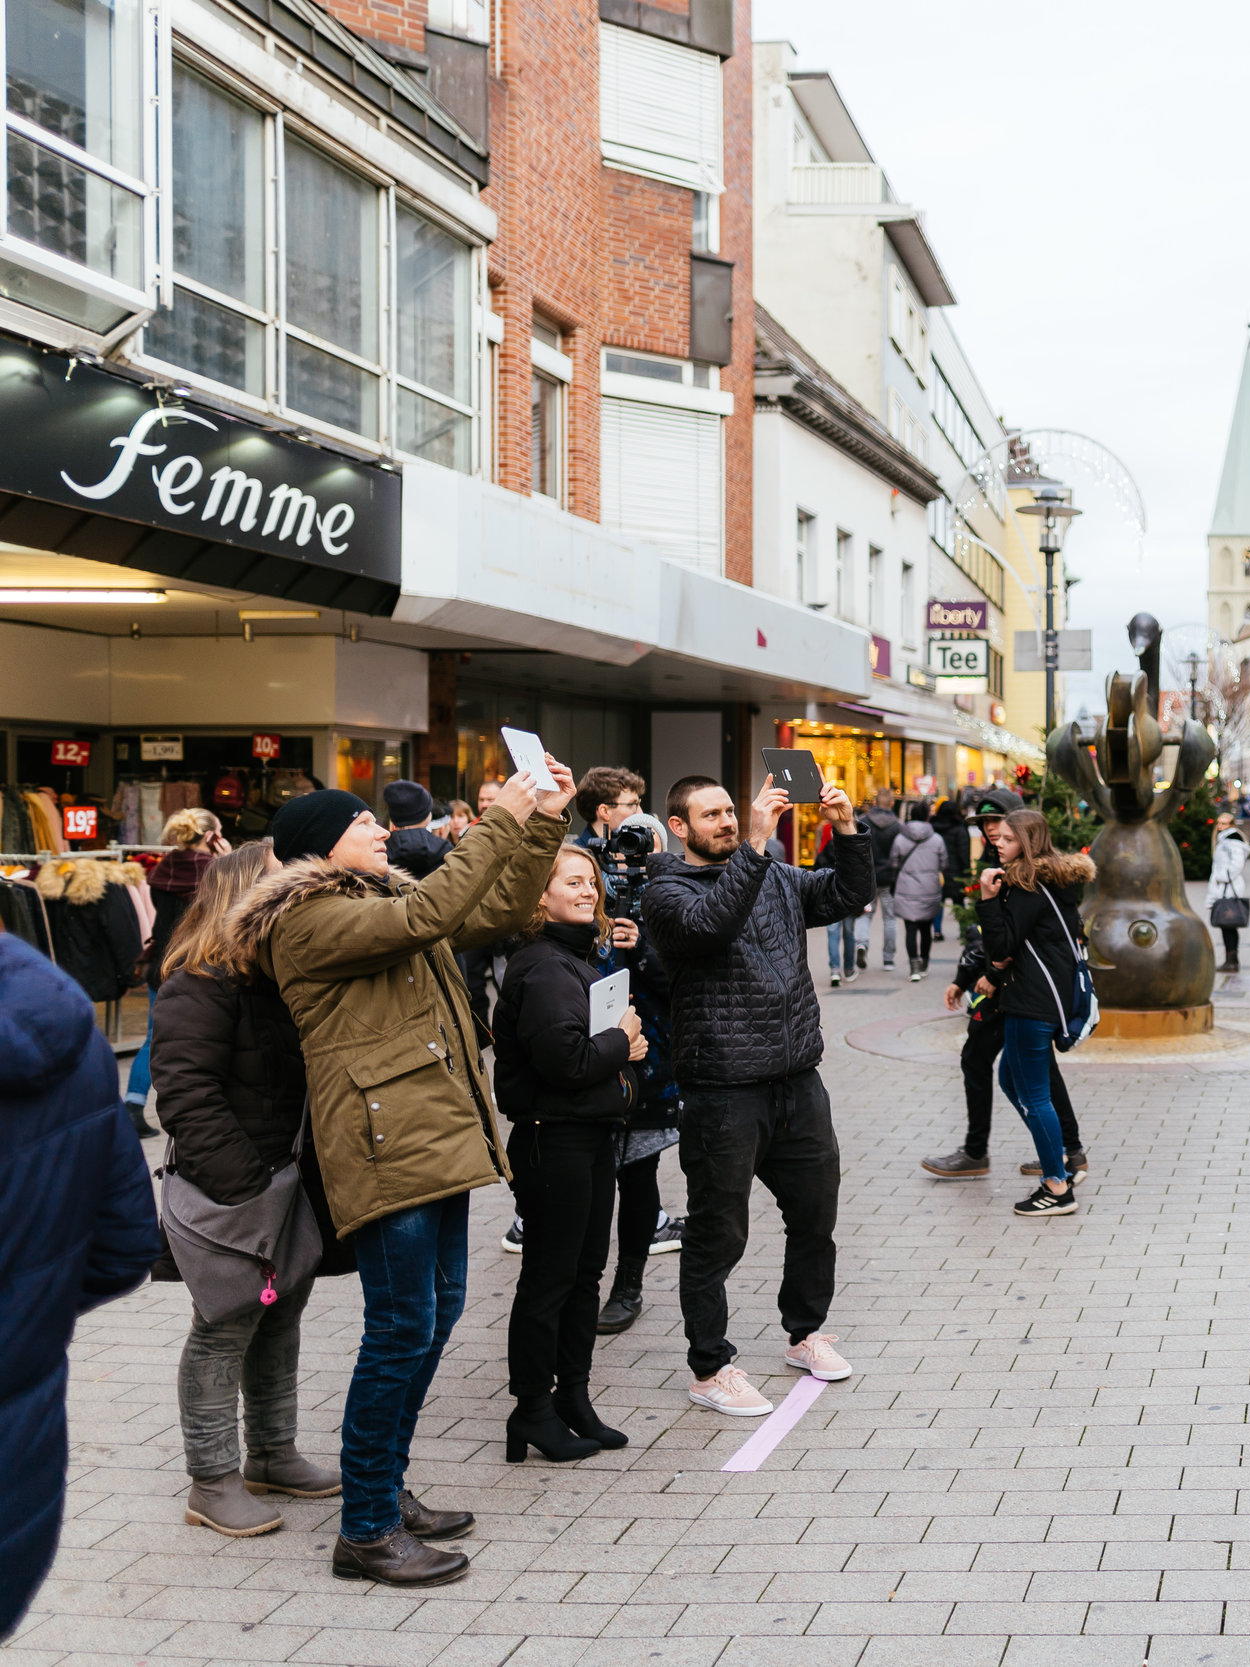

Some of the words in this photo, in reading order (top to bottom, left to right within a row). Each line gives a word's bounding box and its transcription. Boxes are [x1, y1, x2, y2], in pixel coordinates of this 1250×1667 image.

[929, 604, 983, 628] liberty
[937, 647, 978, 670] Tee
[55, 743, 89, 764] 12,-
[255, 736, 279, 756] 10,-
